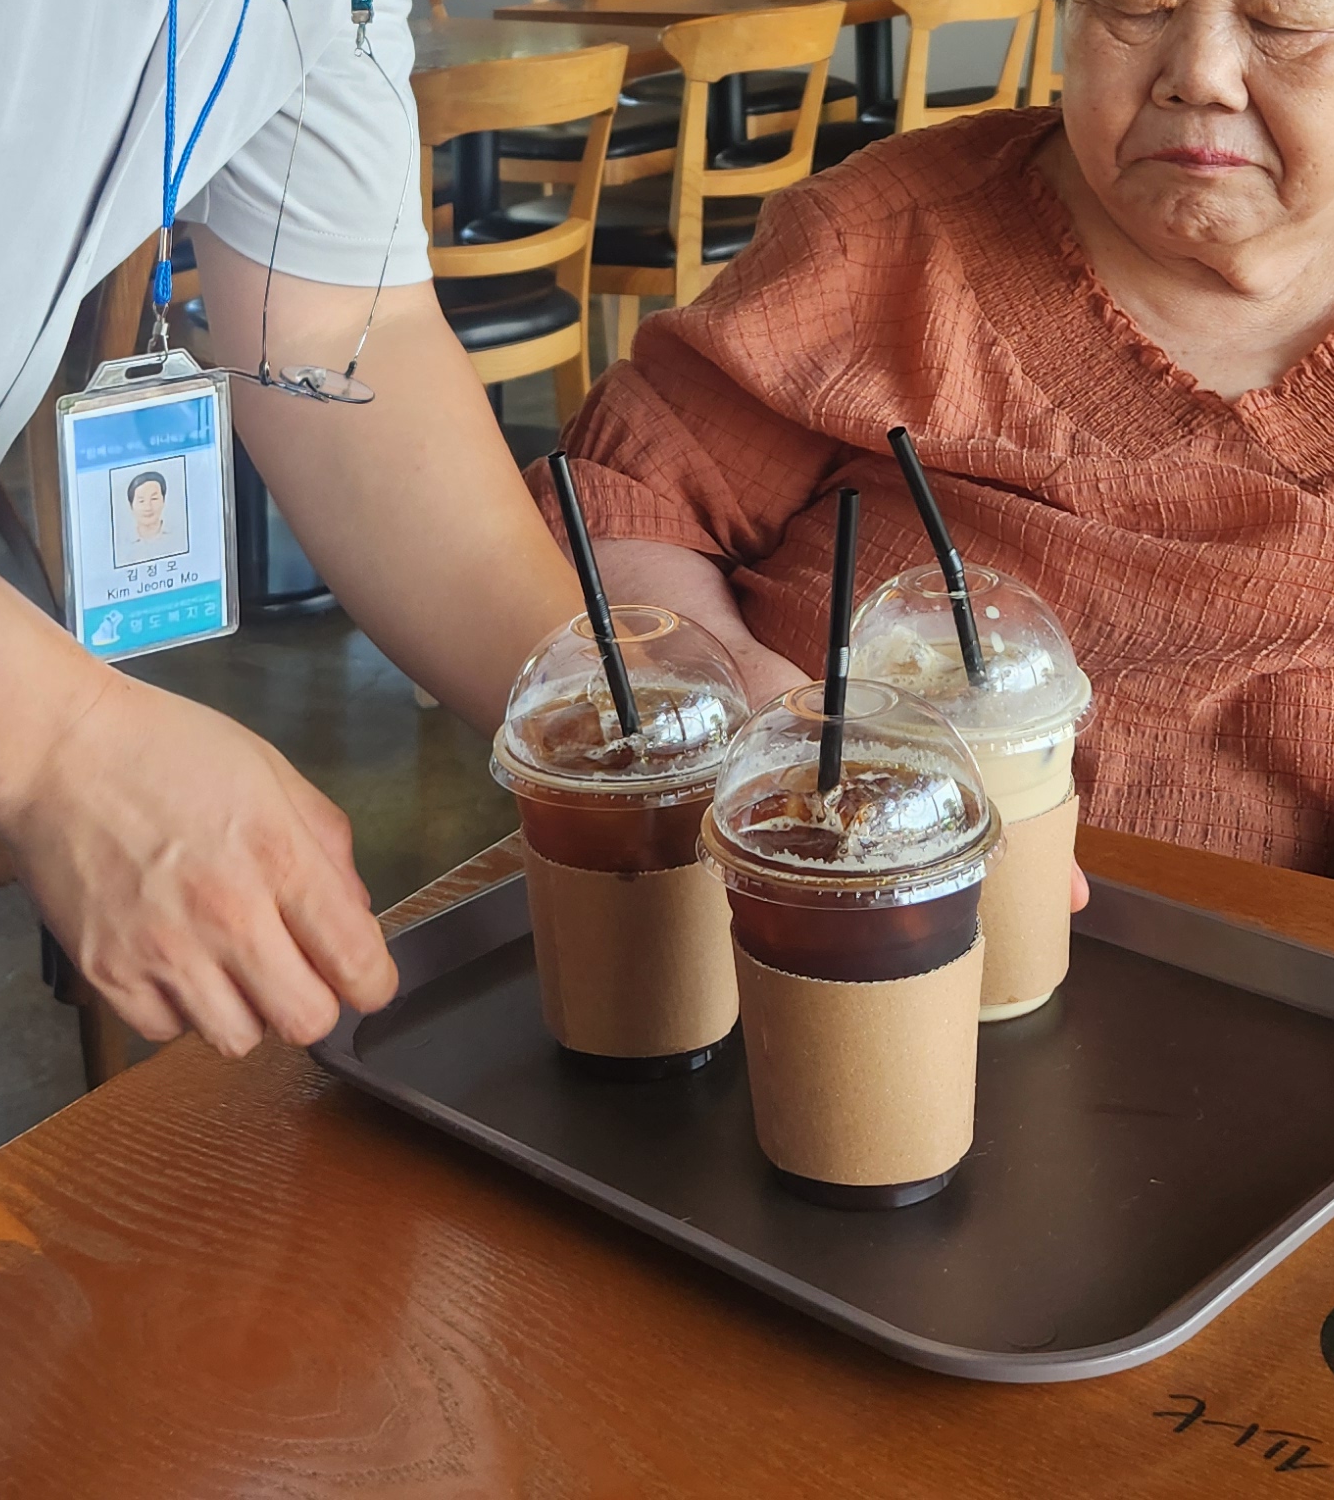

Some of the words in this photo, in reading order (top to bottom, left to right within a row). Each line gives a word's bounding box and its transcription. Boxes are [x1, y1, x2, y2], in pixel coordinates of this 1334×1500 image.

[107, 586, 130, 601] Kim
[137, 577, 174, 594] Jeong
[180, 571, 199, 585] Mo
